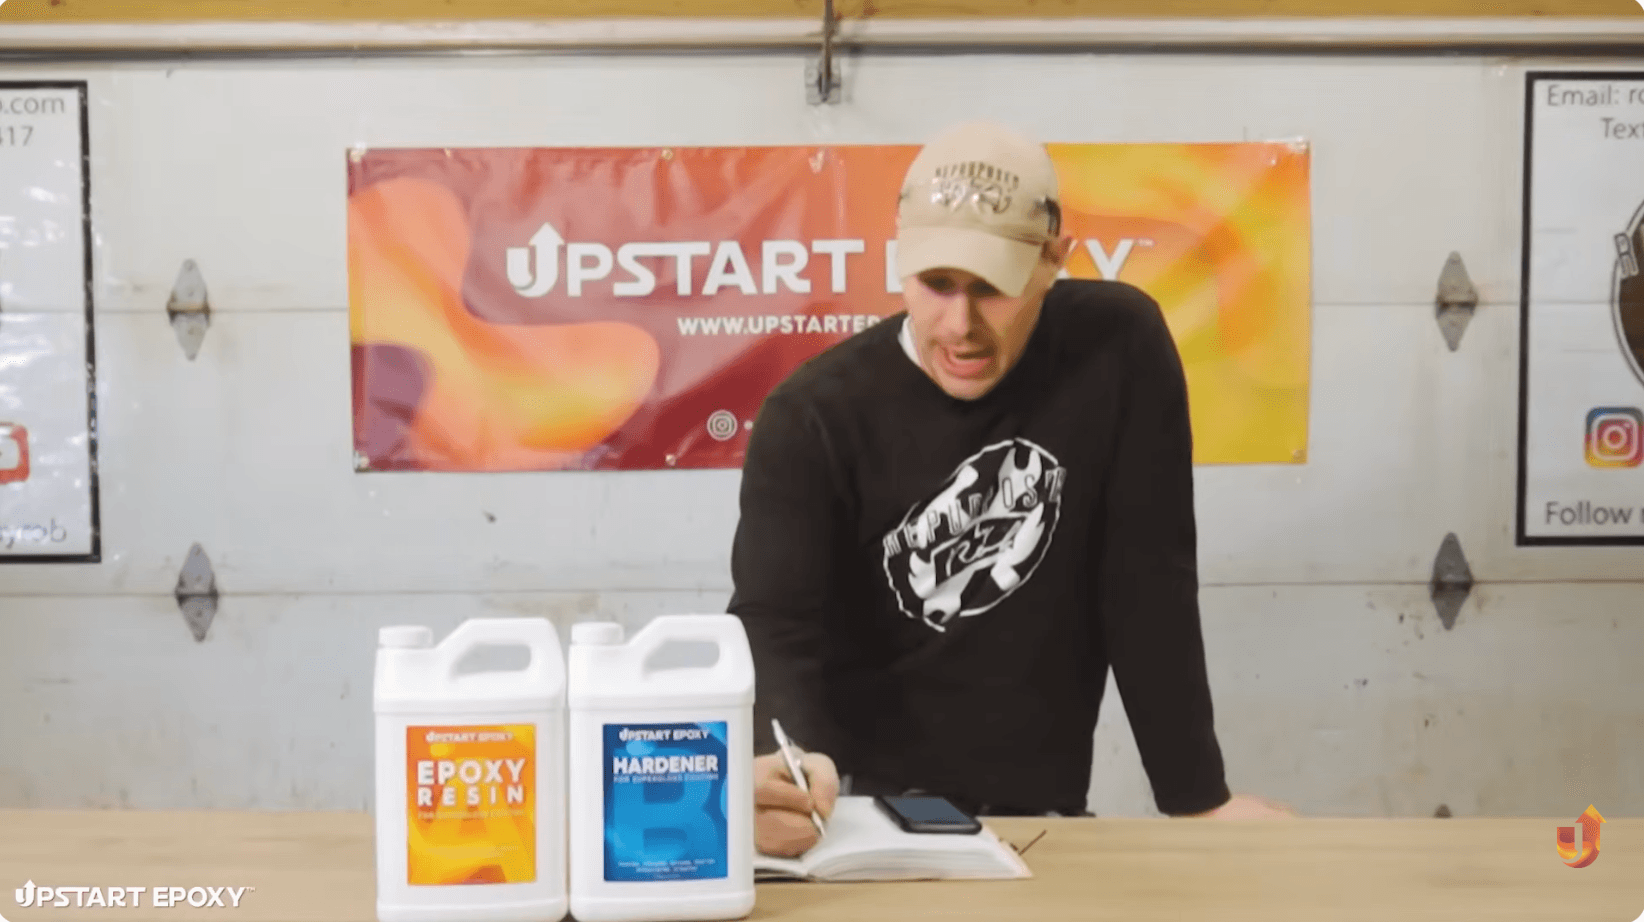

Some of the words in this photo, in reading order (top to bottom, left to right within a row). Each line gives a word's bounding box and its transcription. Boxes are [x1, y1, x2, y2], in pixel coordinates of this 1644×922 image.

[0, 96, 65, 115] .com
[1547, 84, 1620, 106] Email:
[0, 125, 34, 147] 17
[506, 222, 865, 298] UPSTART
[1545, 500, 1633, 526] Follow
[418, 758, 526, 785] EPOXY
[613, 755, 719, 774] HARDENER
[418, 784, 524, 807] RESIN
